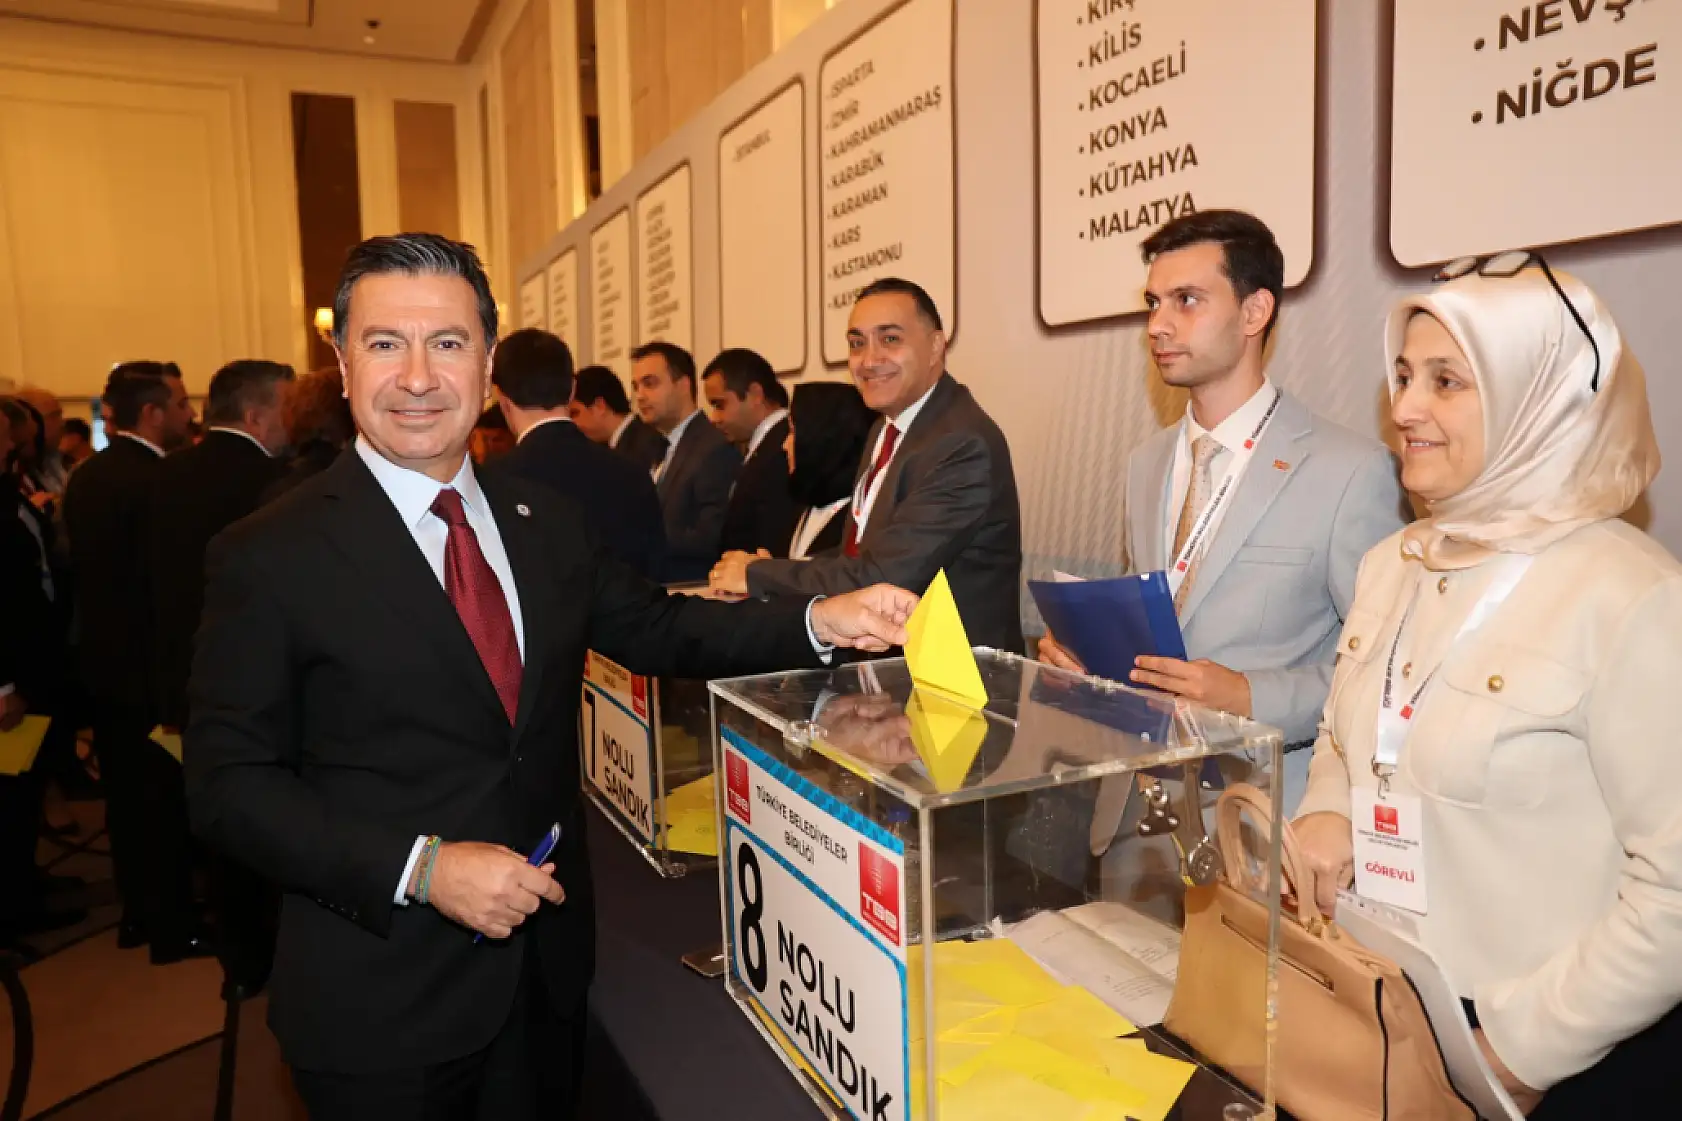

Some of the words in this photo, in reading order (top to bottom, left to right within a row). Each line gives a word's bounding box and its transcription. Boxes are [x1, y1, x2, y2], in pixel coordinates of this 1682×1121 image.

[1088, 21, 1142, 67] KİLİS
[1088, 40, 1186, 111] KOCAELİ
[1496, 42, 1658, 124] NİĞDE
[1088, 106, 1168, 155] KONYA
[1088, 143, 1198, 198] KÜTAHYA
[603, 730, 634, 781] NOLU
[604, 766, 650, 834] SANDIK
[738, 842, 768, 993] 8
[778, 919, 856, 1033] NOLU
[780, 979, 893, 1121] SANDIK
